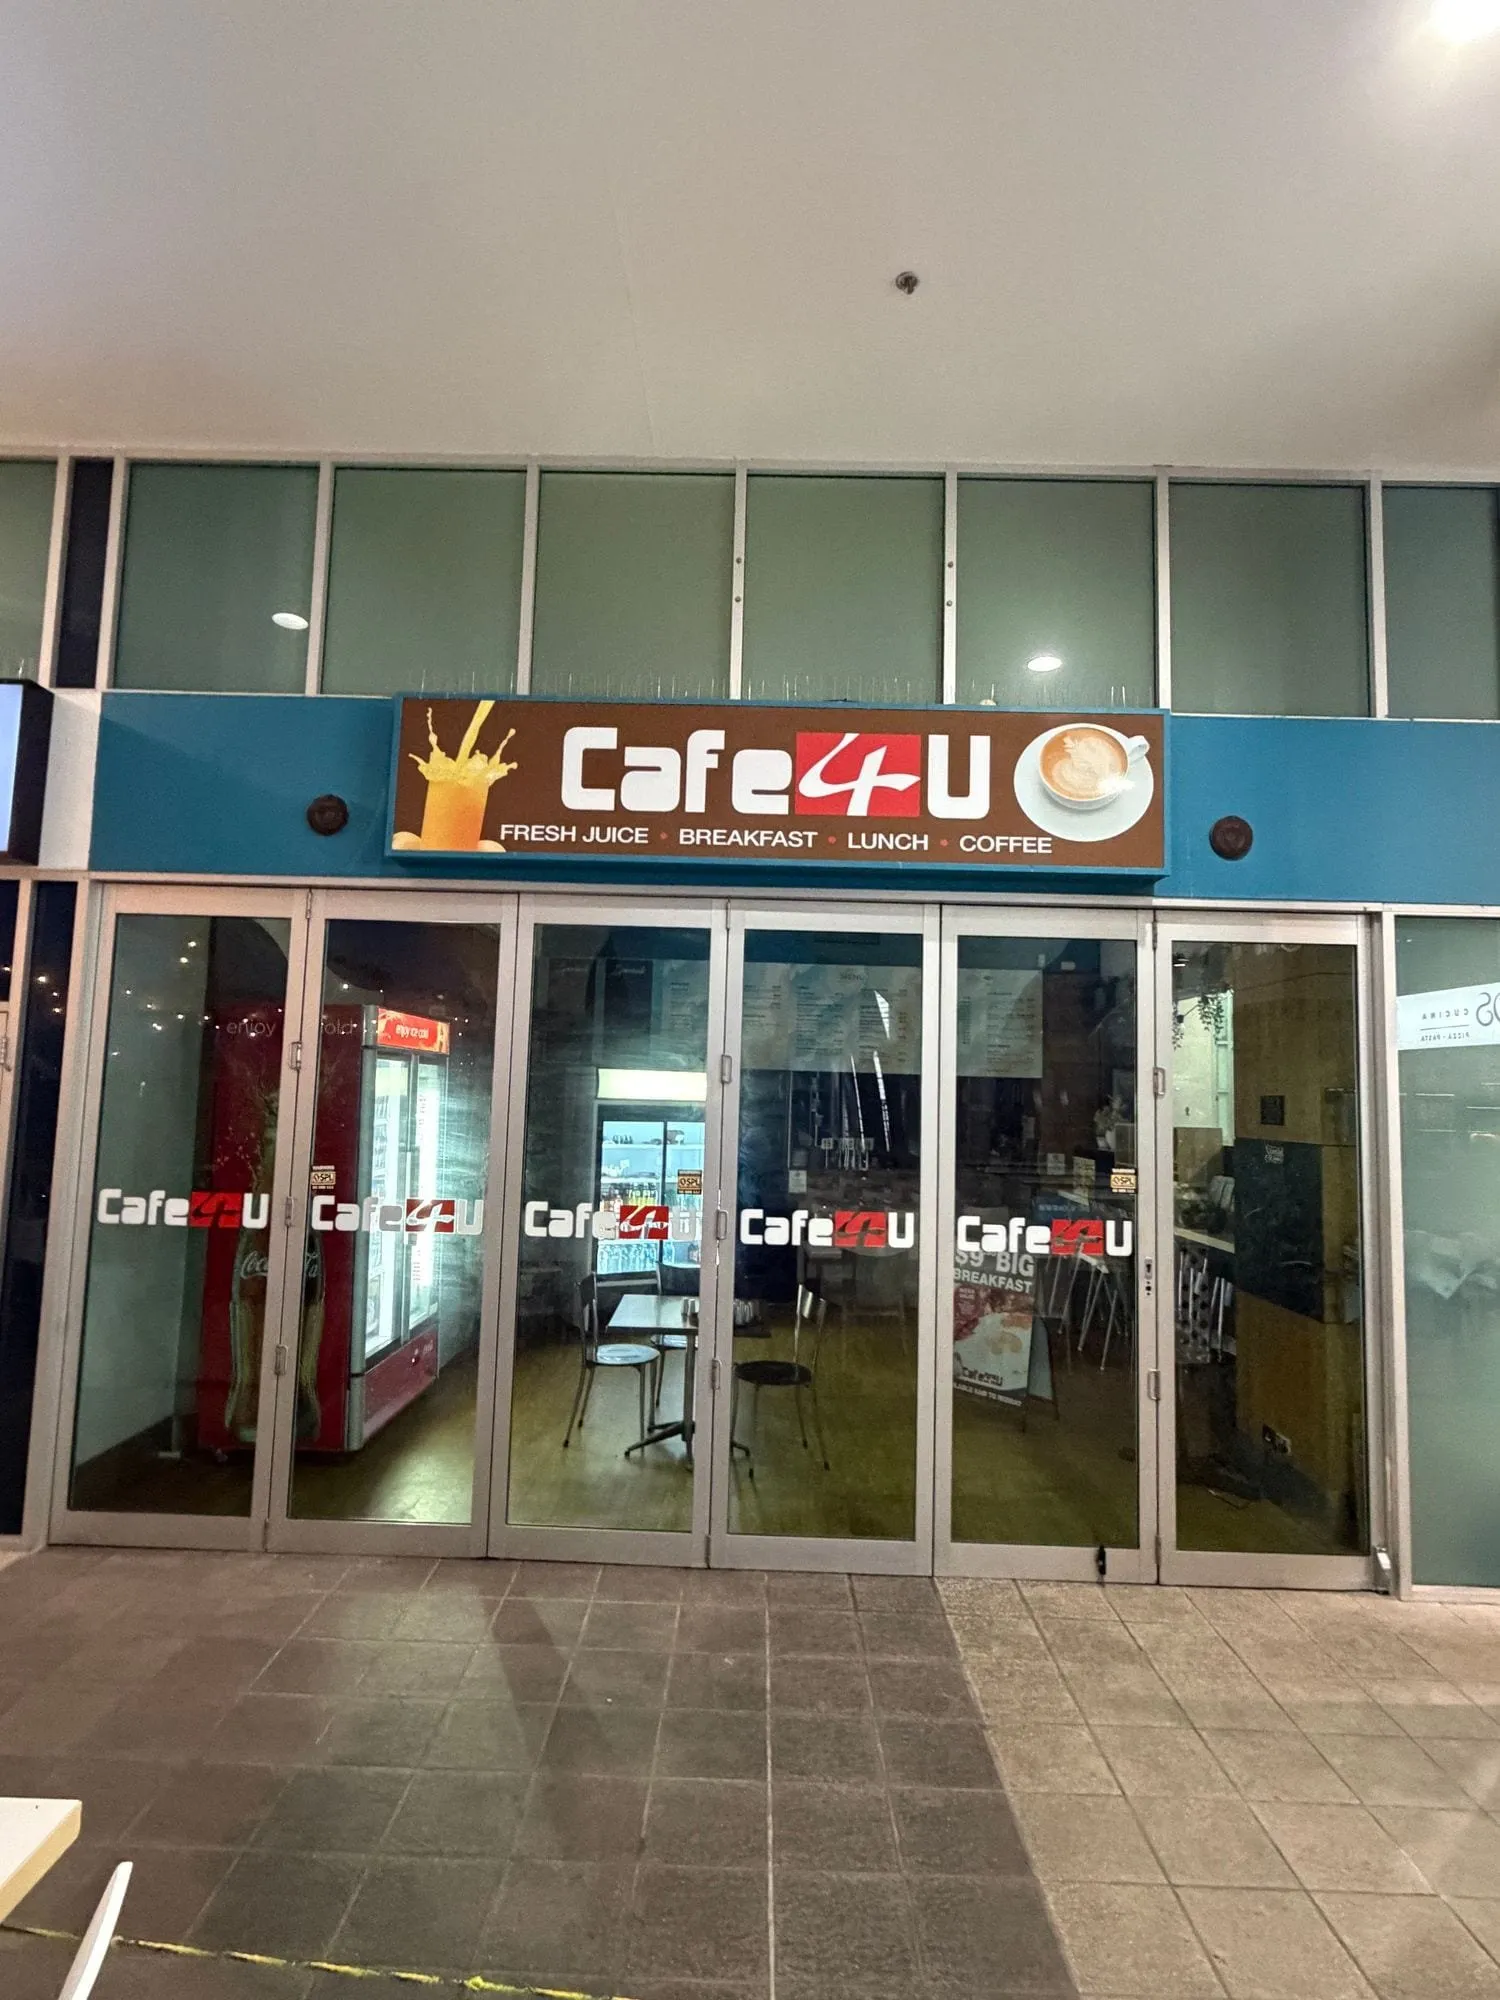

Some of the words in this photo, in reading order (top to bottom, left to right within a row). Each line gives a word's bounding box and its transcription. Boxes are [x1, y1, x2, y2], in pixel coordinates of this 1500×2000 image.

[561, 726, 991, 819] Cafe4U
[500, 823, 575, 845] FRESH
[582, 825, 649, 846] JUICE
[678, 828, 818, 850] BREAKFAST
[847, 832, 930, 852] LUNCH
[959, 834, 1053, 856] COFFEE
[97, 1188, 269, 1229] Cafe4U
[311, 1194, 483, 1235] Cafe4U
[740, 1208, 916, 1250] Cafe4U
[958, 1216, 1133, 1256] Cafe4U
[953, 1267, 1033, 1294] BREAKFAST
[995, 1250, 1035, 1278] BIG
